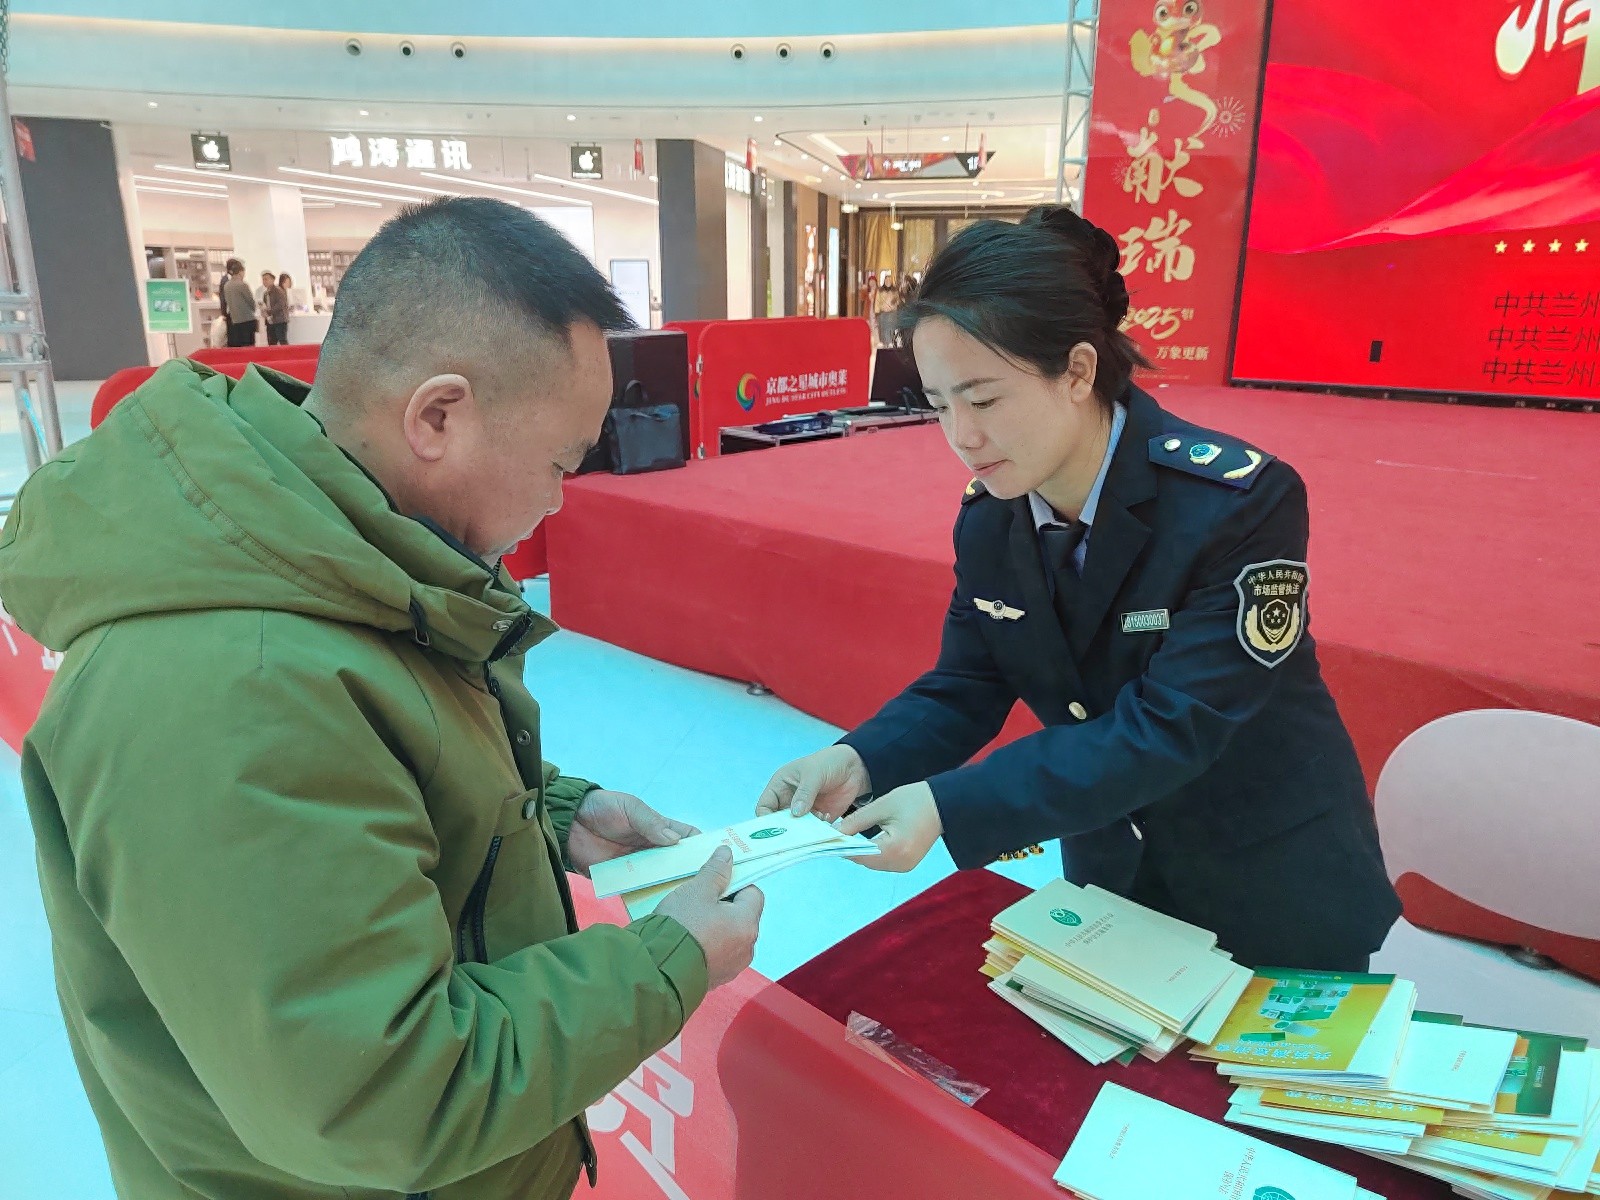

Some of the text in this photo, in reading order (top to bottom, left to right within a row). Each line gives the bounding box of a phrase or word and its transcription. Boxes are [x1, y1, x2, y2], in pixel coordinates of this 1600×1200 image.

[1494, 290, 1600, 318] 中共兰州
[1488, 324, 1600, 353] 中共兰州
[1156, 345, 1210, 361] 万象更新
[765, 369, 848, 395] 京都之星城市奥莱
[1482, 357, 1600, 387] 中共兰州
[1253, 583, 1300, 597] 市场监督执法
